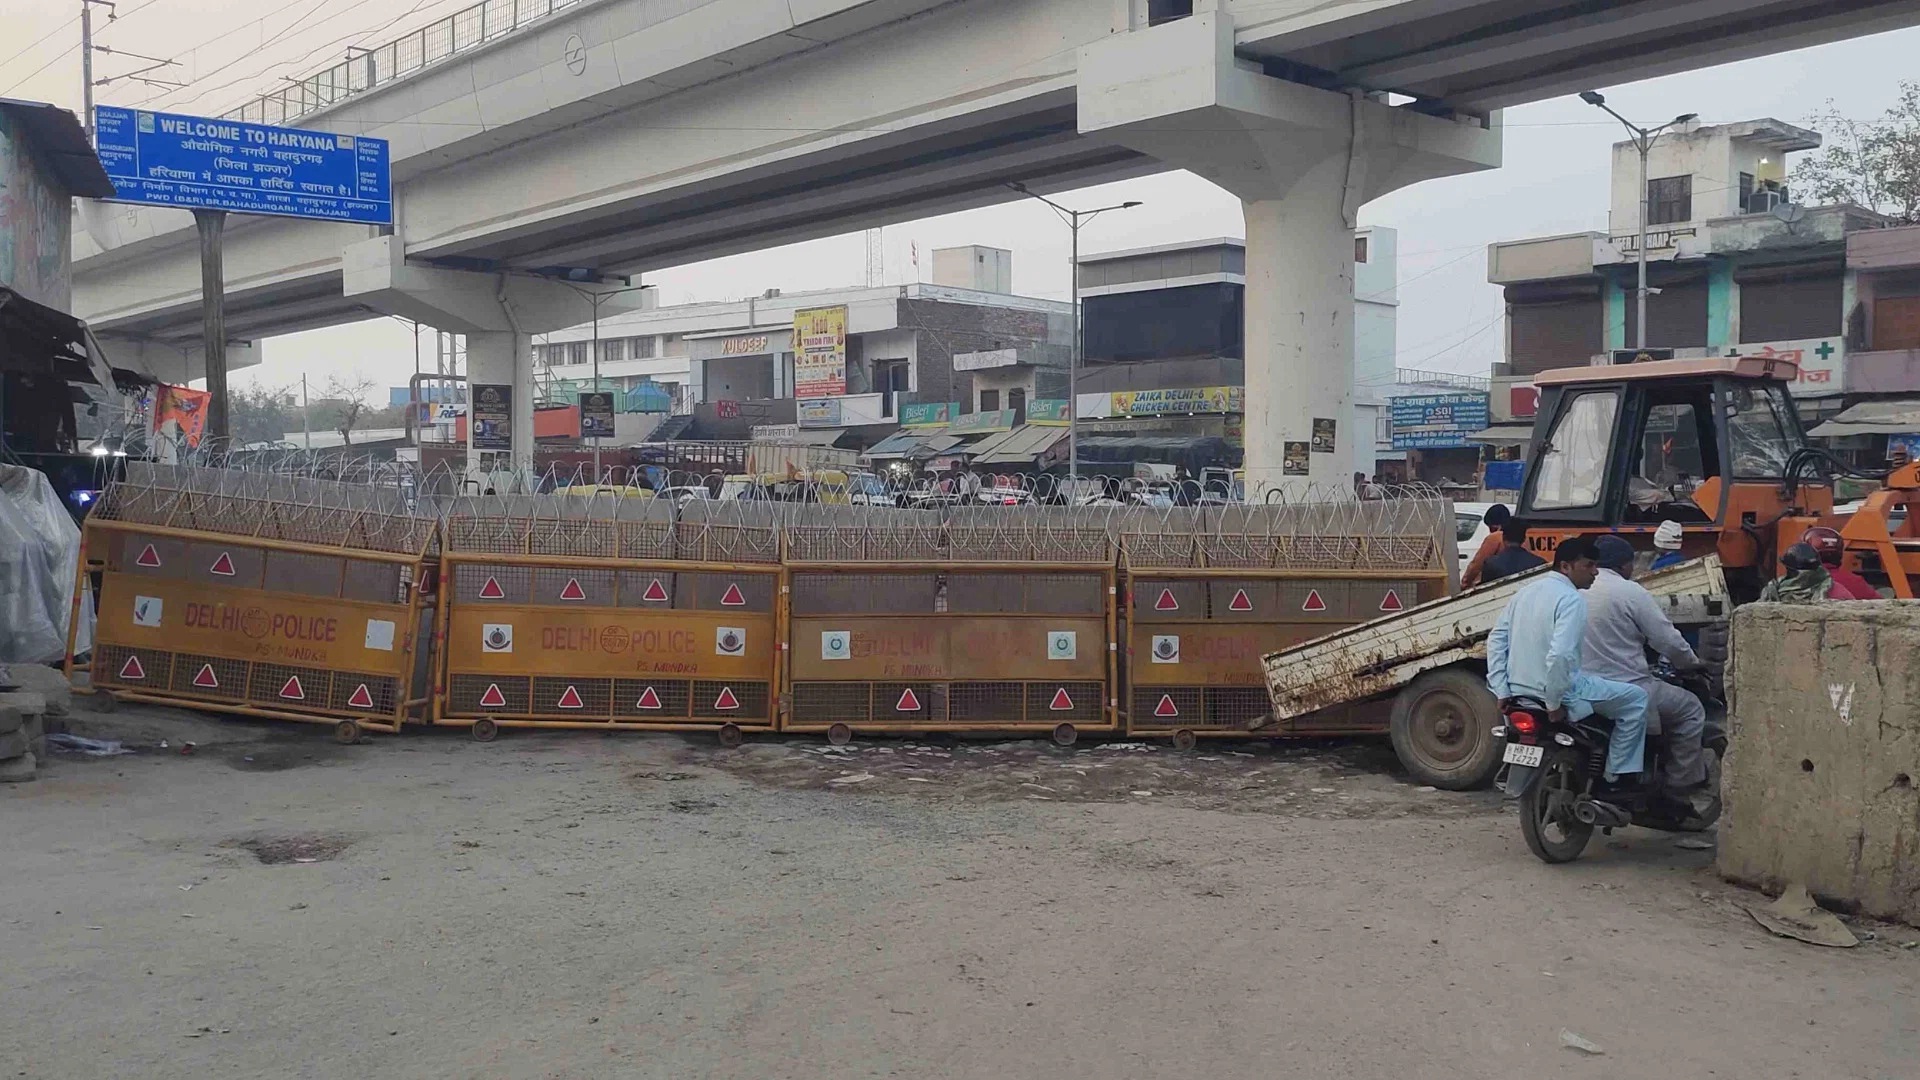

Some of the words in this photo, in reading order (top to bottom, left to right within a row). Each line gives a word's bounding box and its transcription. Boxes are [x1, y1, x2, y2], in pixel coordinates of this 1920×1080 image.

[160, 118, 240, 141] WELCOME
[245, 129, 265, 144] TO
[268, 132, 335, 152] HARYANA
[181, 138, 234, 155] औद्योगिक
[240, 146, 268, 159] नगरी
[213, 156, 248, 172] (जिला
[253, 162, 293, 177] झज्जर)
[143, 180, 174, 193] निर्माण
[179, 184, 209, 195] विभाग
[148, 165, 196, 181] हरियाणा
[202, 169, 212, 182] में
[217, 174, 253, 187] आपका
[260, 176, 294, 190] हार्दिक
[300, 182, 334, 194] स्वागत
[146, 193, 170, 201] PWD
[304, 207, 350, 217] (JHAJJAR)
[721, 336, 768, 355] KULDEEP
[1134, 391, 1163, 401] ZAIKA
[1165, 389, 1204, 400] DELHI-6
[1439, 395, 1459, 404] सेवा
[905, 405, 929, 419] Bisleri
[1030, 401, 1052, 413] Bisleri
[1130, 401, 1169, 412] CHICKEN
[1172, 400, 1209, 411] CENTRE
[1435, 406, 1452, 415] SBI
[184, 602, 240, 632] DELHI
[271, 613, 338, 642] POLICE
[542, 627, 597, 650] DELHI
[630, 630, 696, 653] POLICE
